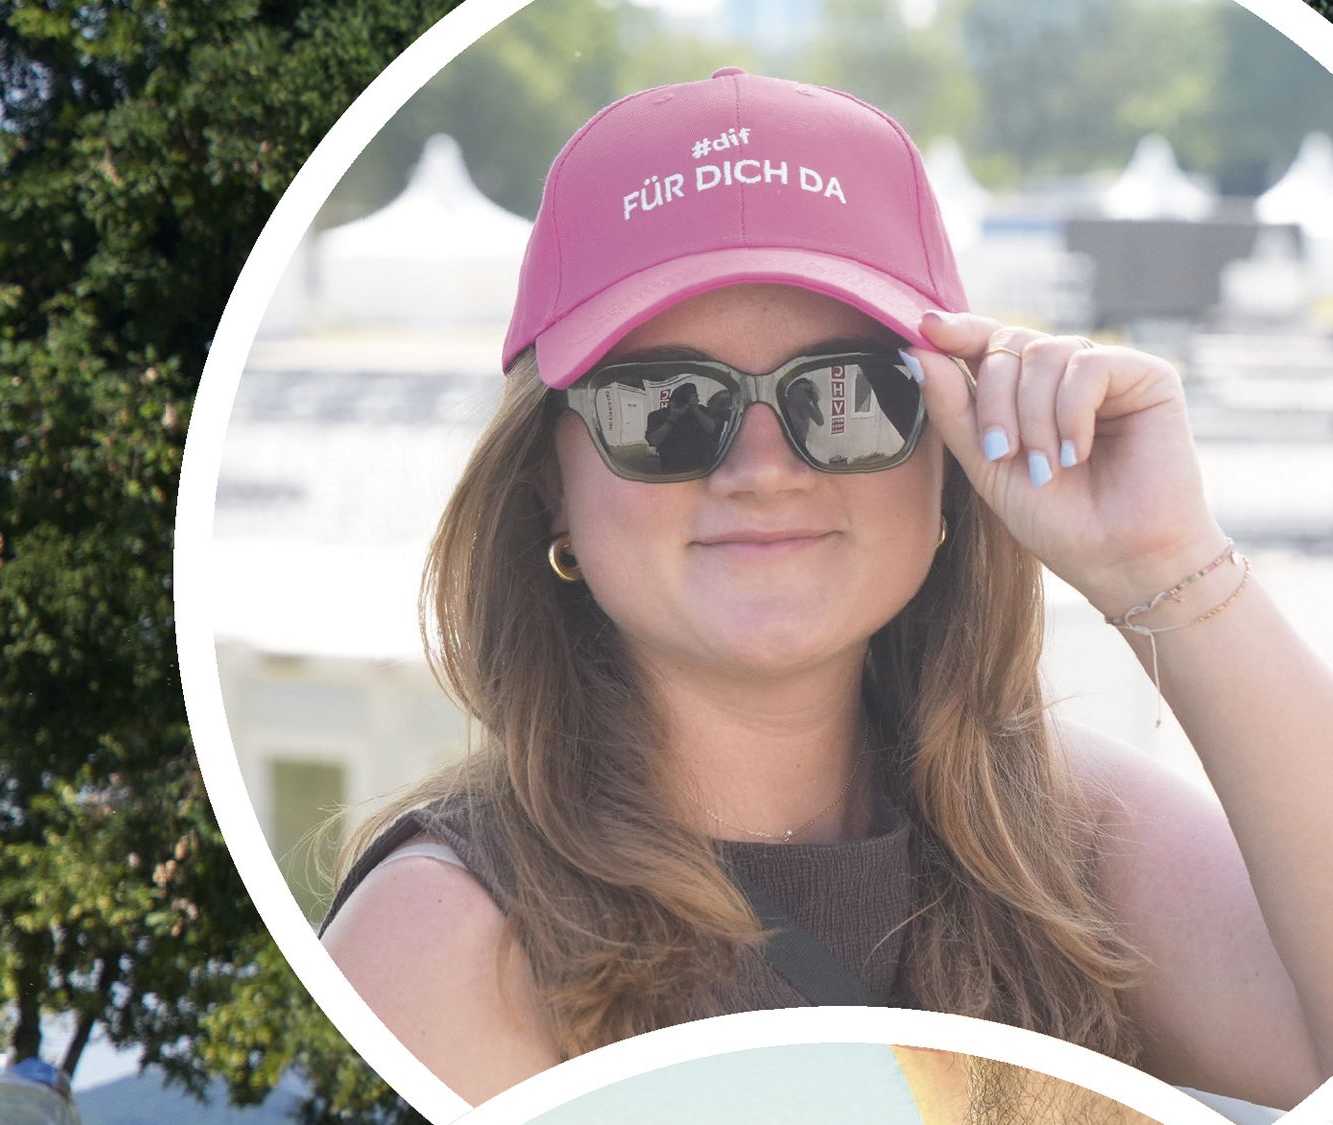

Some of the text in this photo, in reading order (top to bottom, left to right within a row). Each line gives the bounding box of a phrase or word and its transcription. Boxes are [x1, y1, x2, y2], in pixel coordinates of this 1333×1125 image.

[692, 127, 751, 159] #dif
[623, 159, 847, 221] FÜR DICH DA
